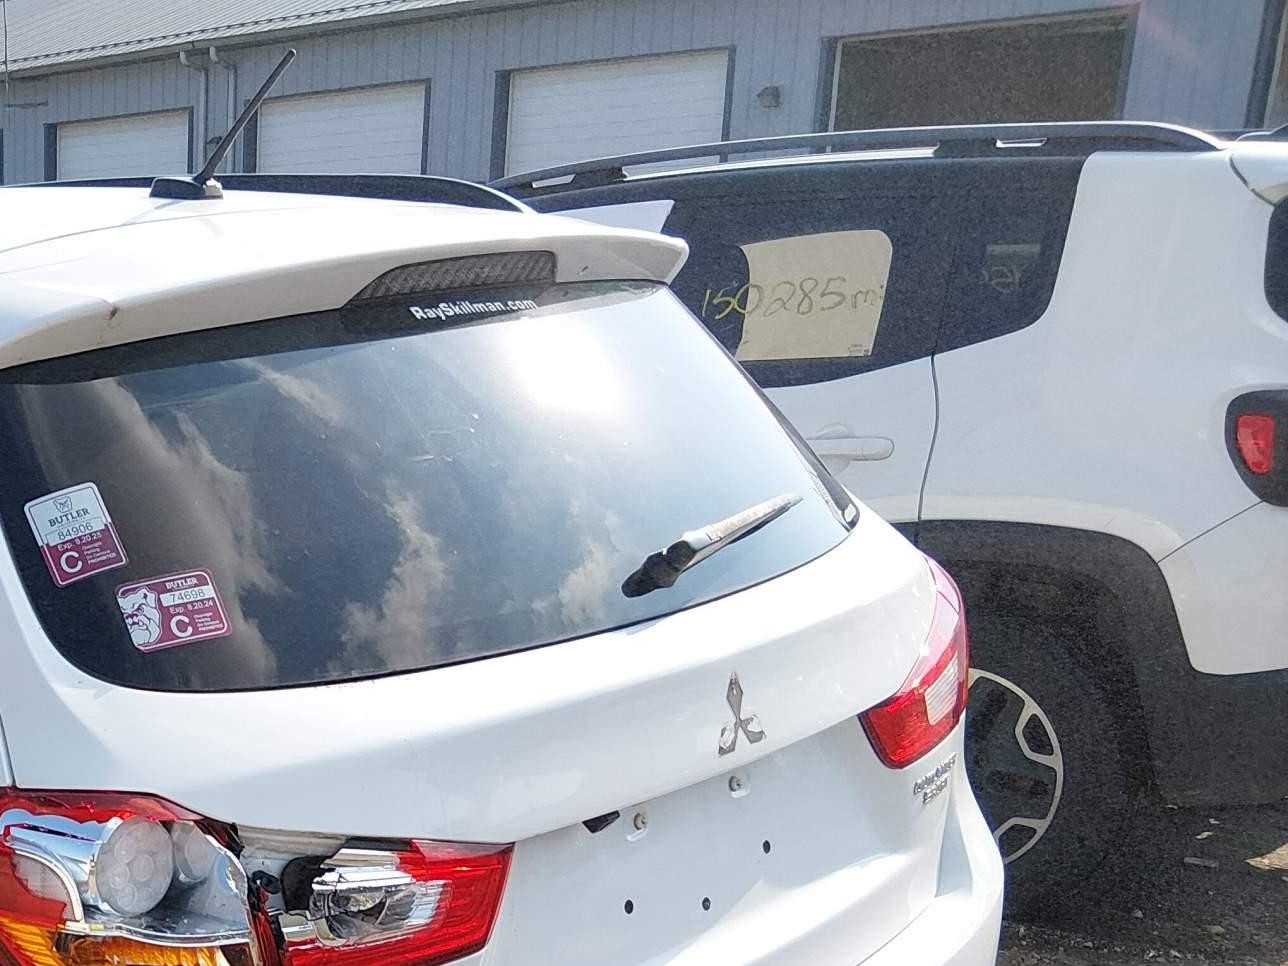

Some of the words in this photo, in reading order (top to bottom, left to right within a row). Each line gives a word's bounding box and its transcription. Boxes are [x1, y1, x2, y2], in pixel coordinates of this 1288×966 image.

[409, 299, 537, 321] RaySkillman.com
[48, 508, 90, 527] BUTLER
[57, 522, 94, 541] 84906
[60, 551, 83, 573] C
[165, 577, 199, 590] BUTLER
[170, 588, 206, 603] 74698
[170, 615, 193, 638] C
